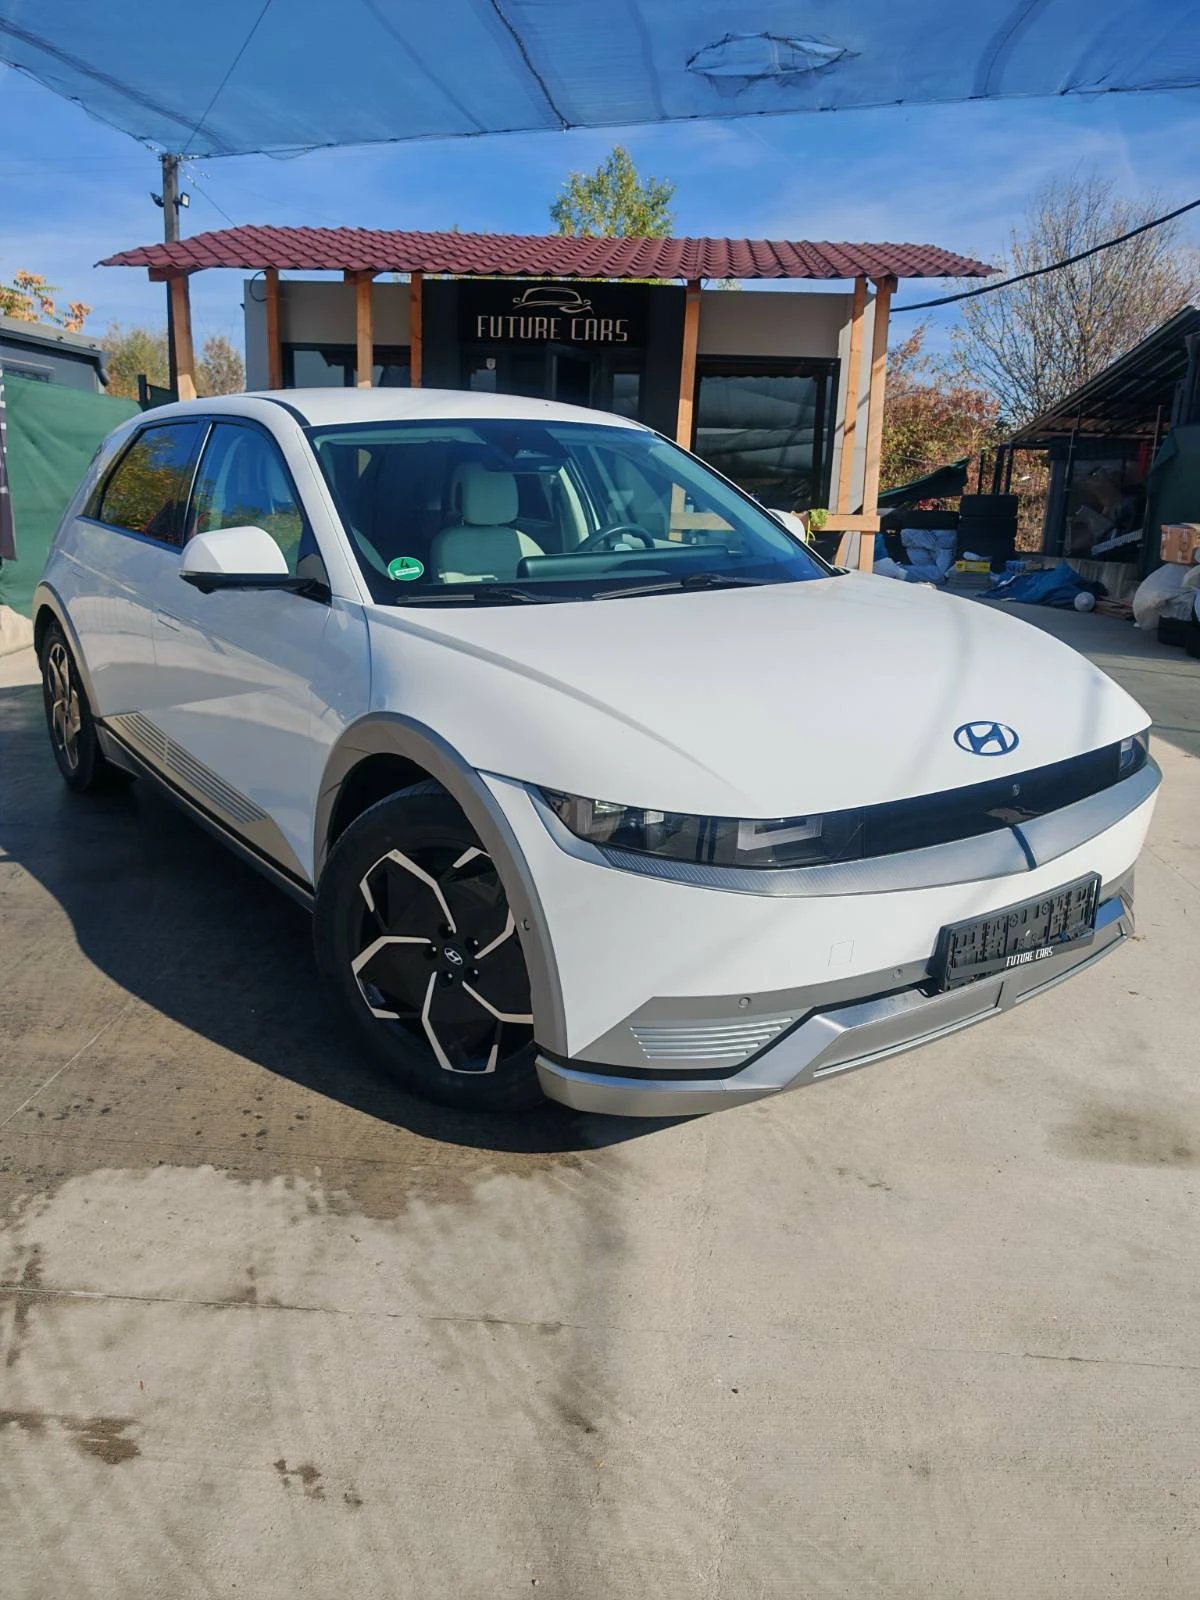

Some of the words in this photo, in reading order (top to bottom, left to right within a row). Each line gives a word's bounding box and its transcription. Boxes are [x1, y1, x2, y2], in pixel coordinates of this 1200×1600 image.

[476, 315, 562, 340] FUTURE
[571, 317, 629, 342] CARS
[1006, 950, 1035, 967] FUTURE
[1035, 945, 1054, 960] CARS
